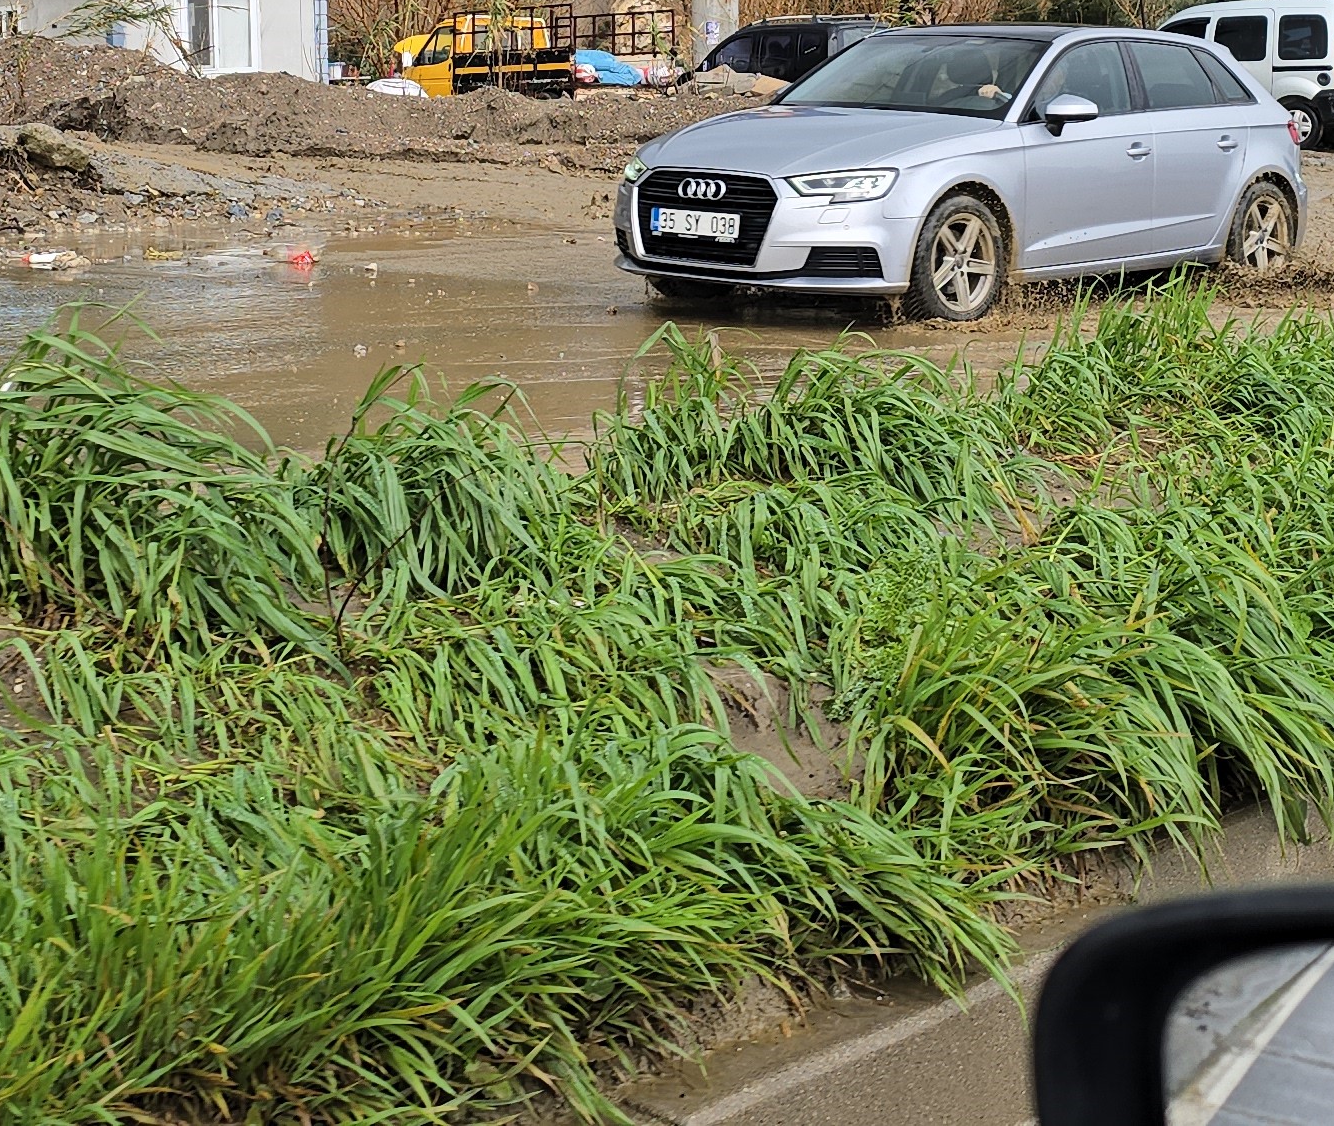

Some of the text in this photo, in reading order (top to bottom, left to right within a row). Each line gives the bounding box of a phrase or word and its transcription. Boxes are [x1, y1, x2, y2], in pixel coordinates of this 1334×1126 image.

[660, 211, 736, 235] 35 SY 038
